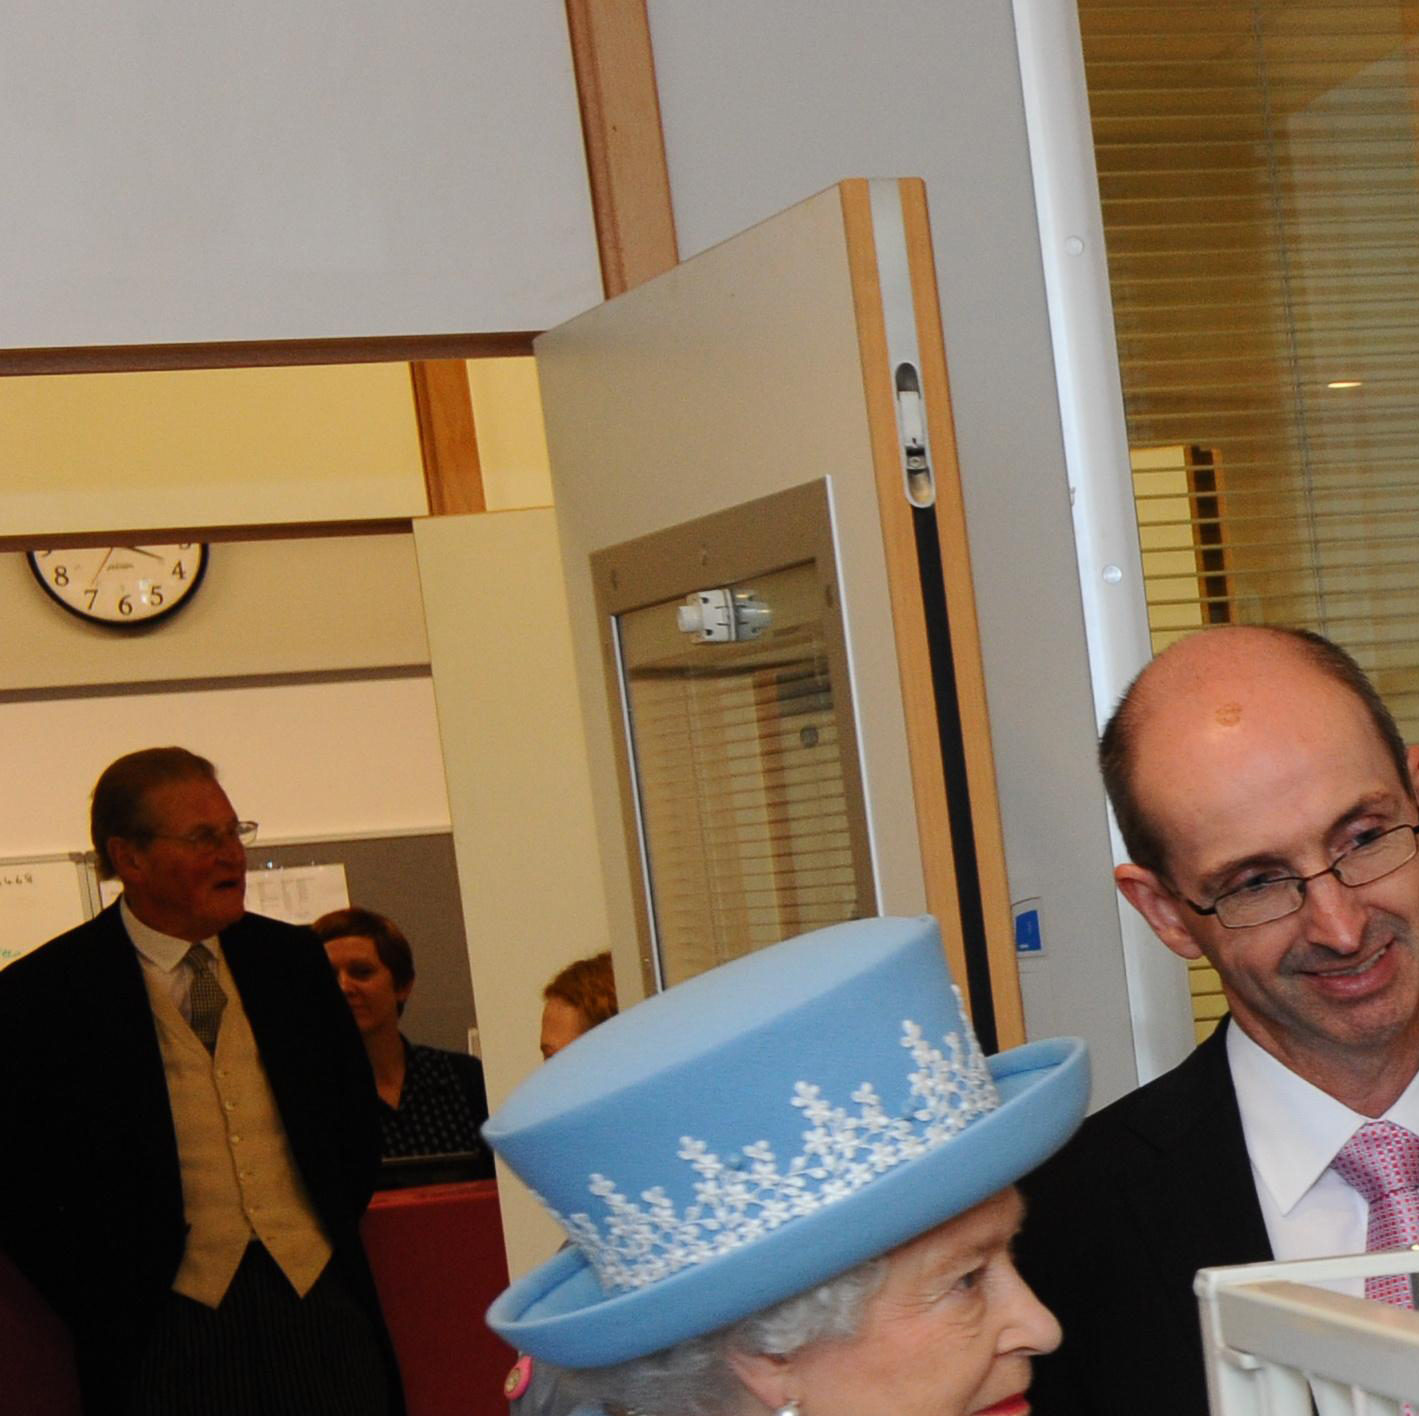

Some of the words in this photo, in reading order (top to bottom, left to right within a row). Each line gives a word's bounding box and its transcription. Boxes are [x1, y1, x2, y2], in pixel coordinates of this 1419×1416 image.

[54, 565, 69, 587] 8
[172, 560, 185, 580] 4
[84, 589, 98, 610] 7
[118, 595, 133, 615] 6
[150, 586, 164, 606] 5
